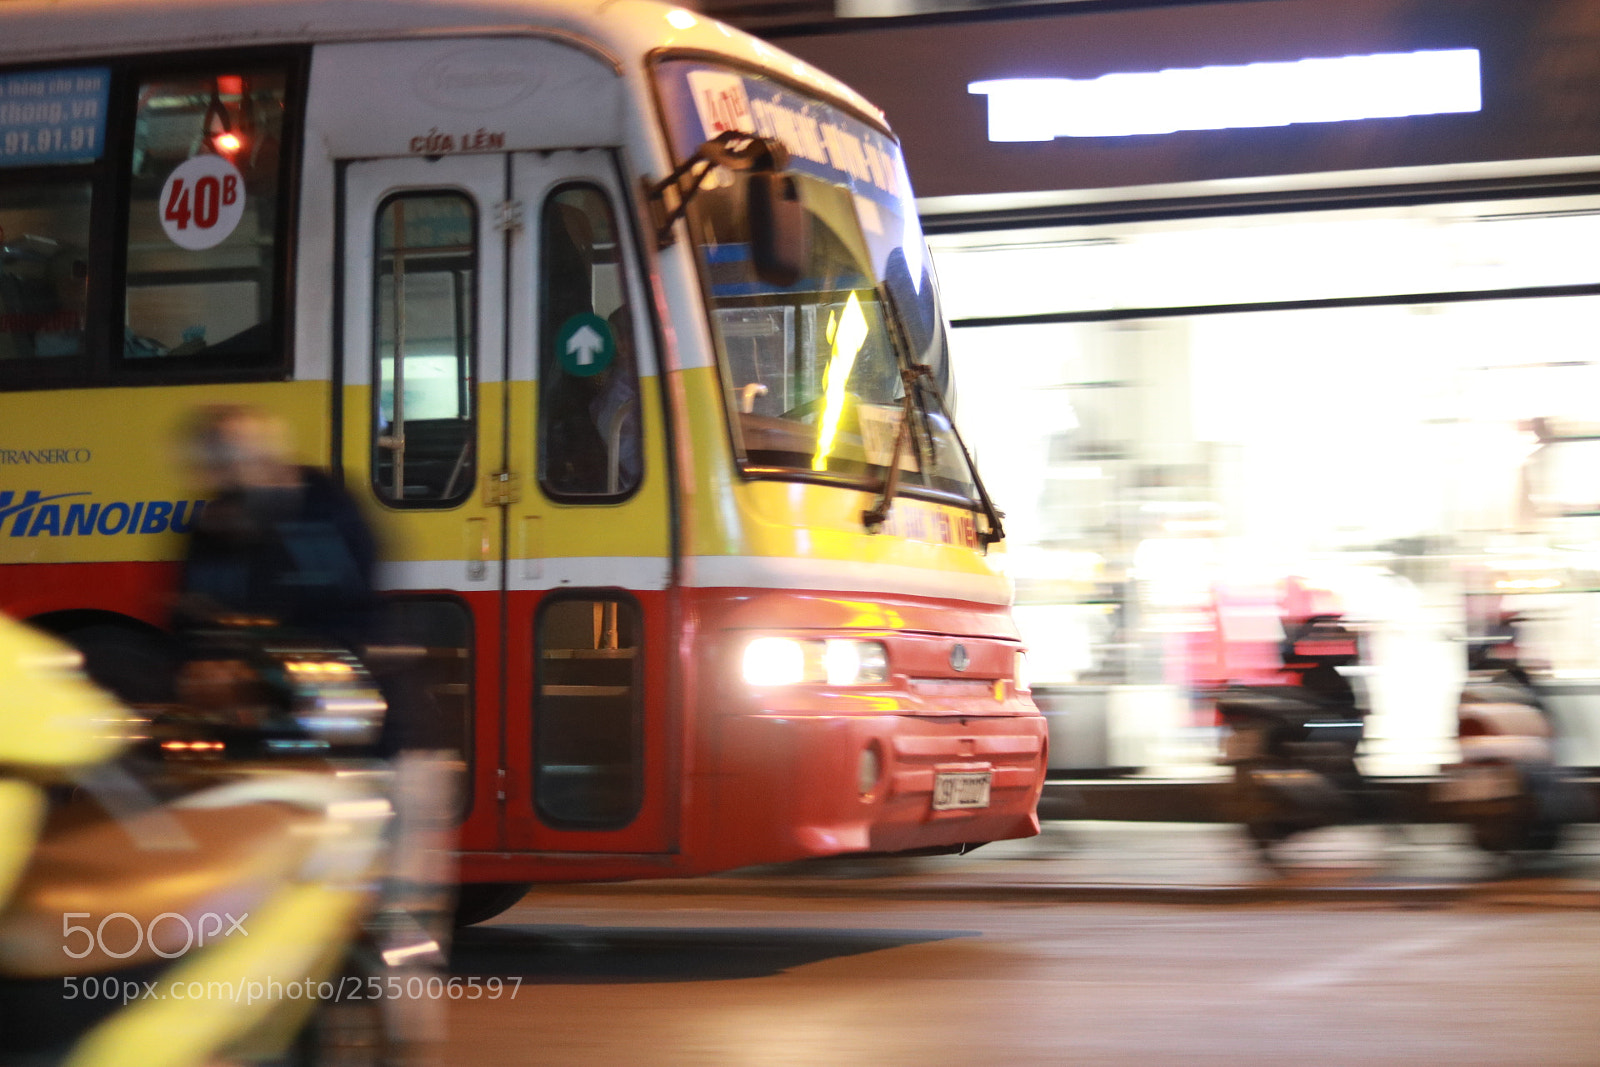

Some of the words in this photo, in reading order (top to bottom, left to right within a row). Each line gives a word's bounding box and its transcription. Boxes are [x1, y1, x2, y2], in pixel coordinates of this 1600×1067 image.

[164, 174, 237, 231] 40B
[0, 448, 91, 465] TRANSERCO
[0, 490, 207, 537] HANOIBU
